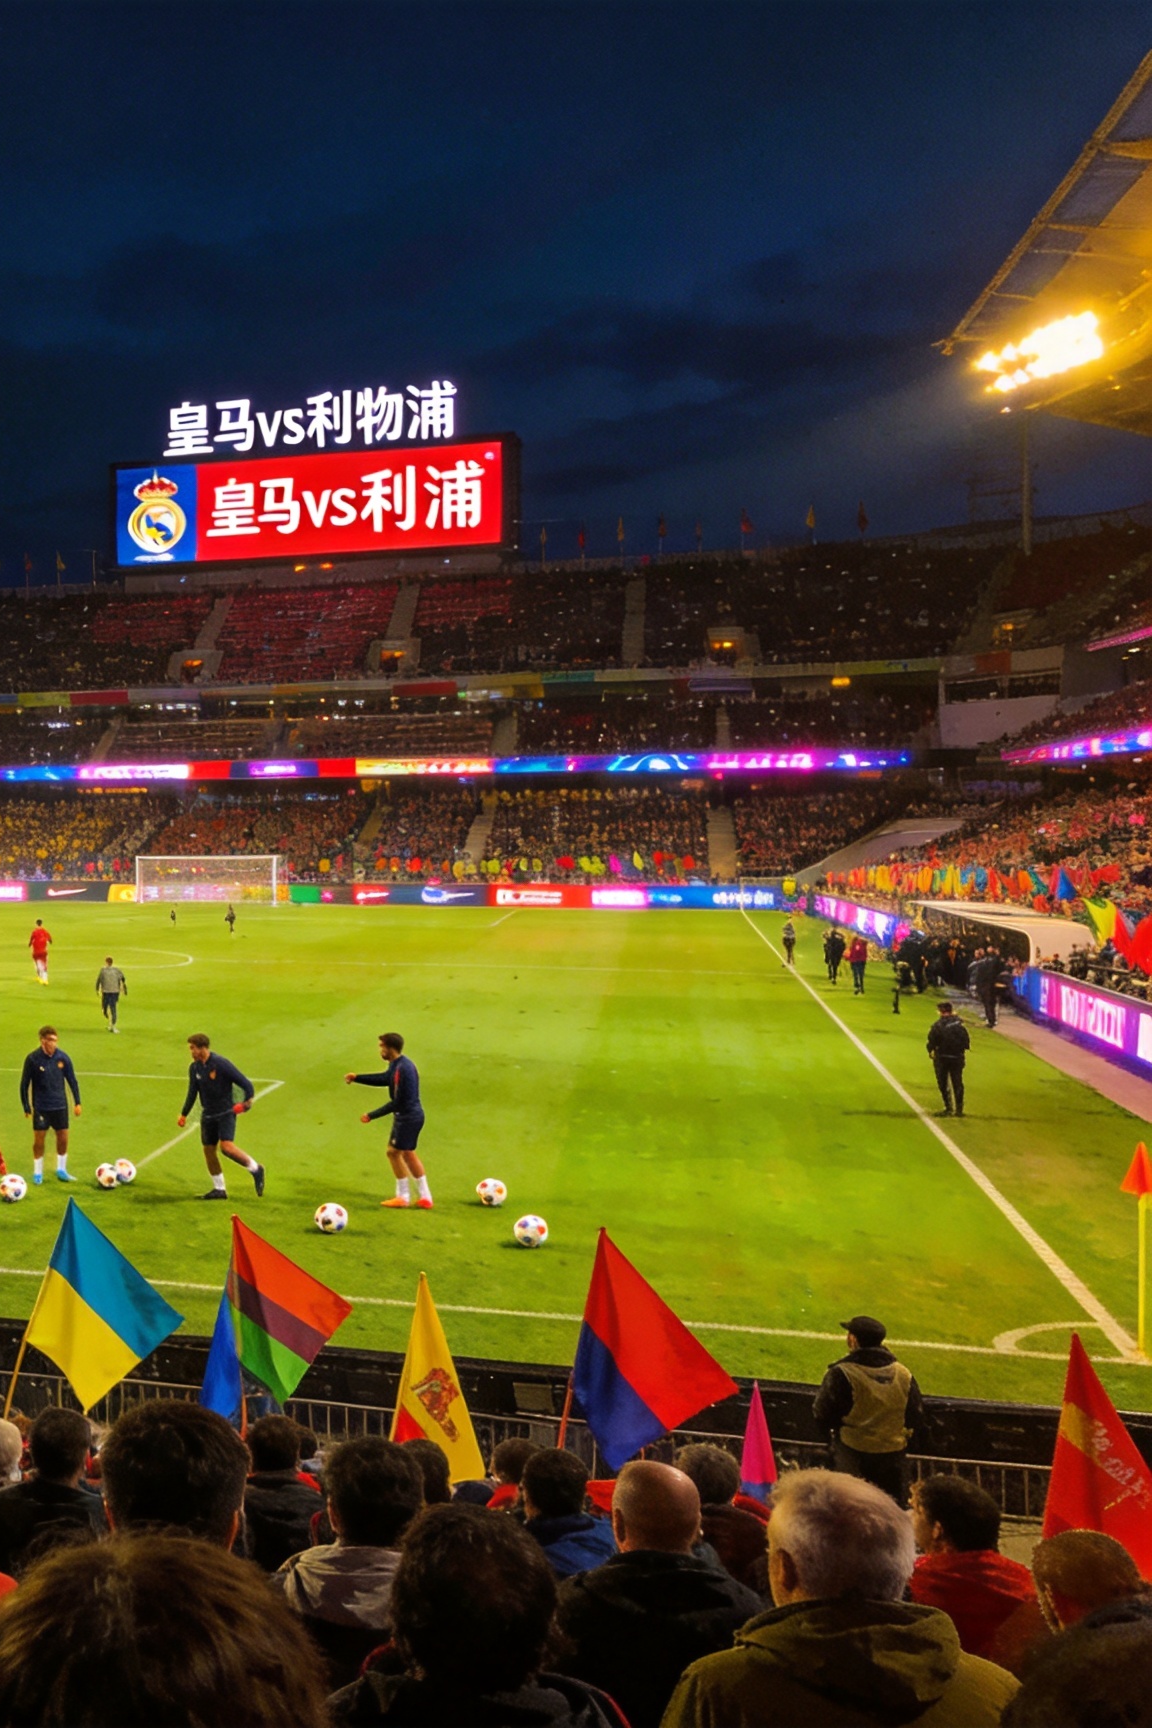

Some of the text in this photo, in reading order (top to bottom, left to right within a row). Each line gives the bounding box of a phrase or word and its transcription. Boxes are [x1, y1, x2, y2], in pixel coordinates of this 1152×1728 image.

[163, 380, 457, 457] 皇马vs利物浦
